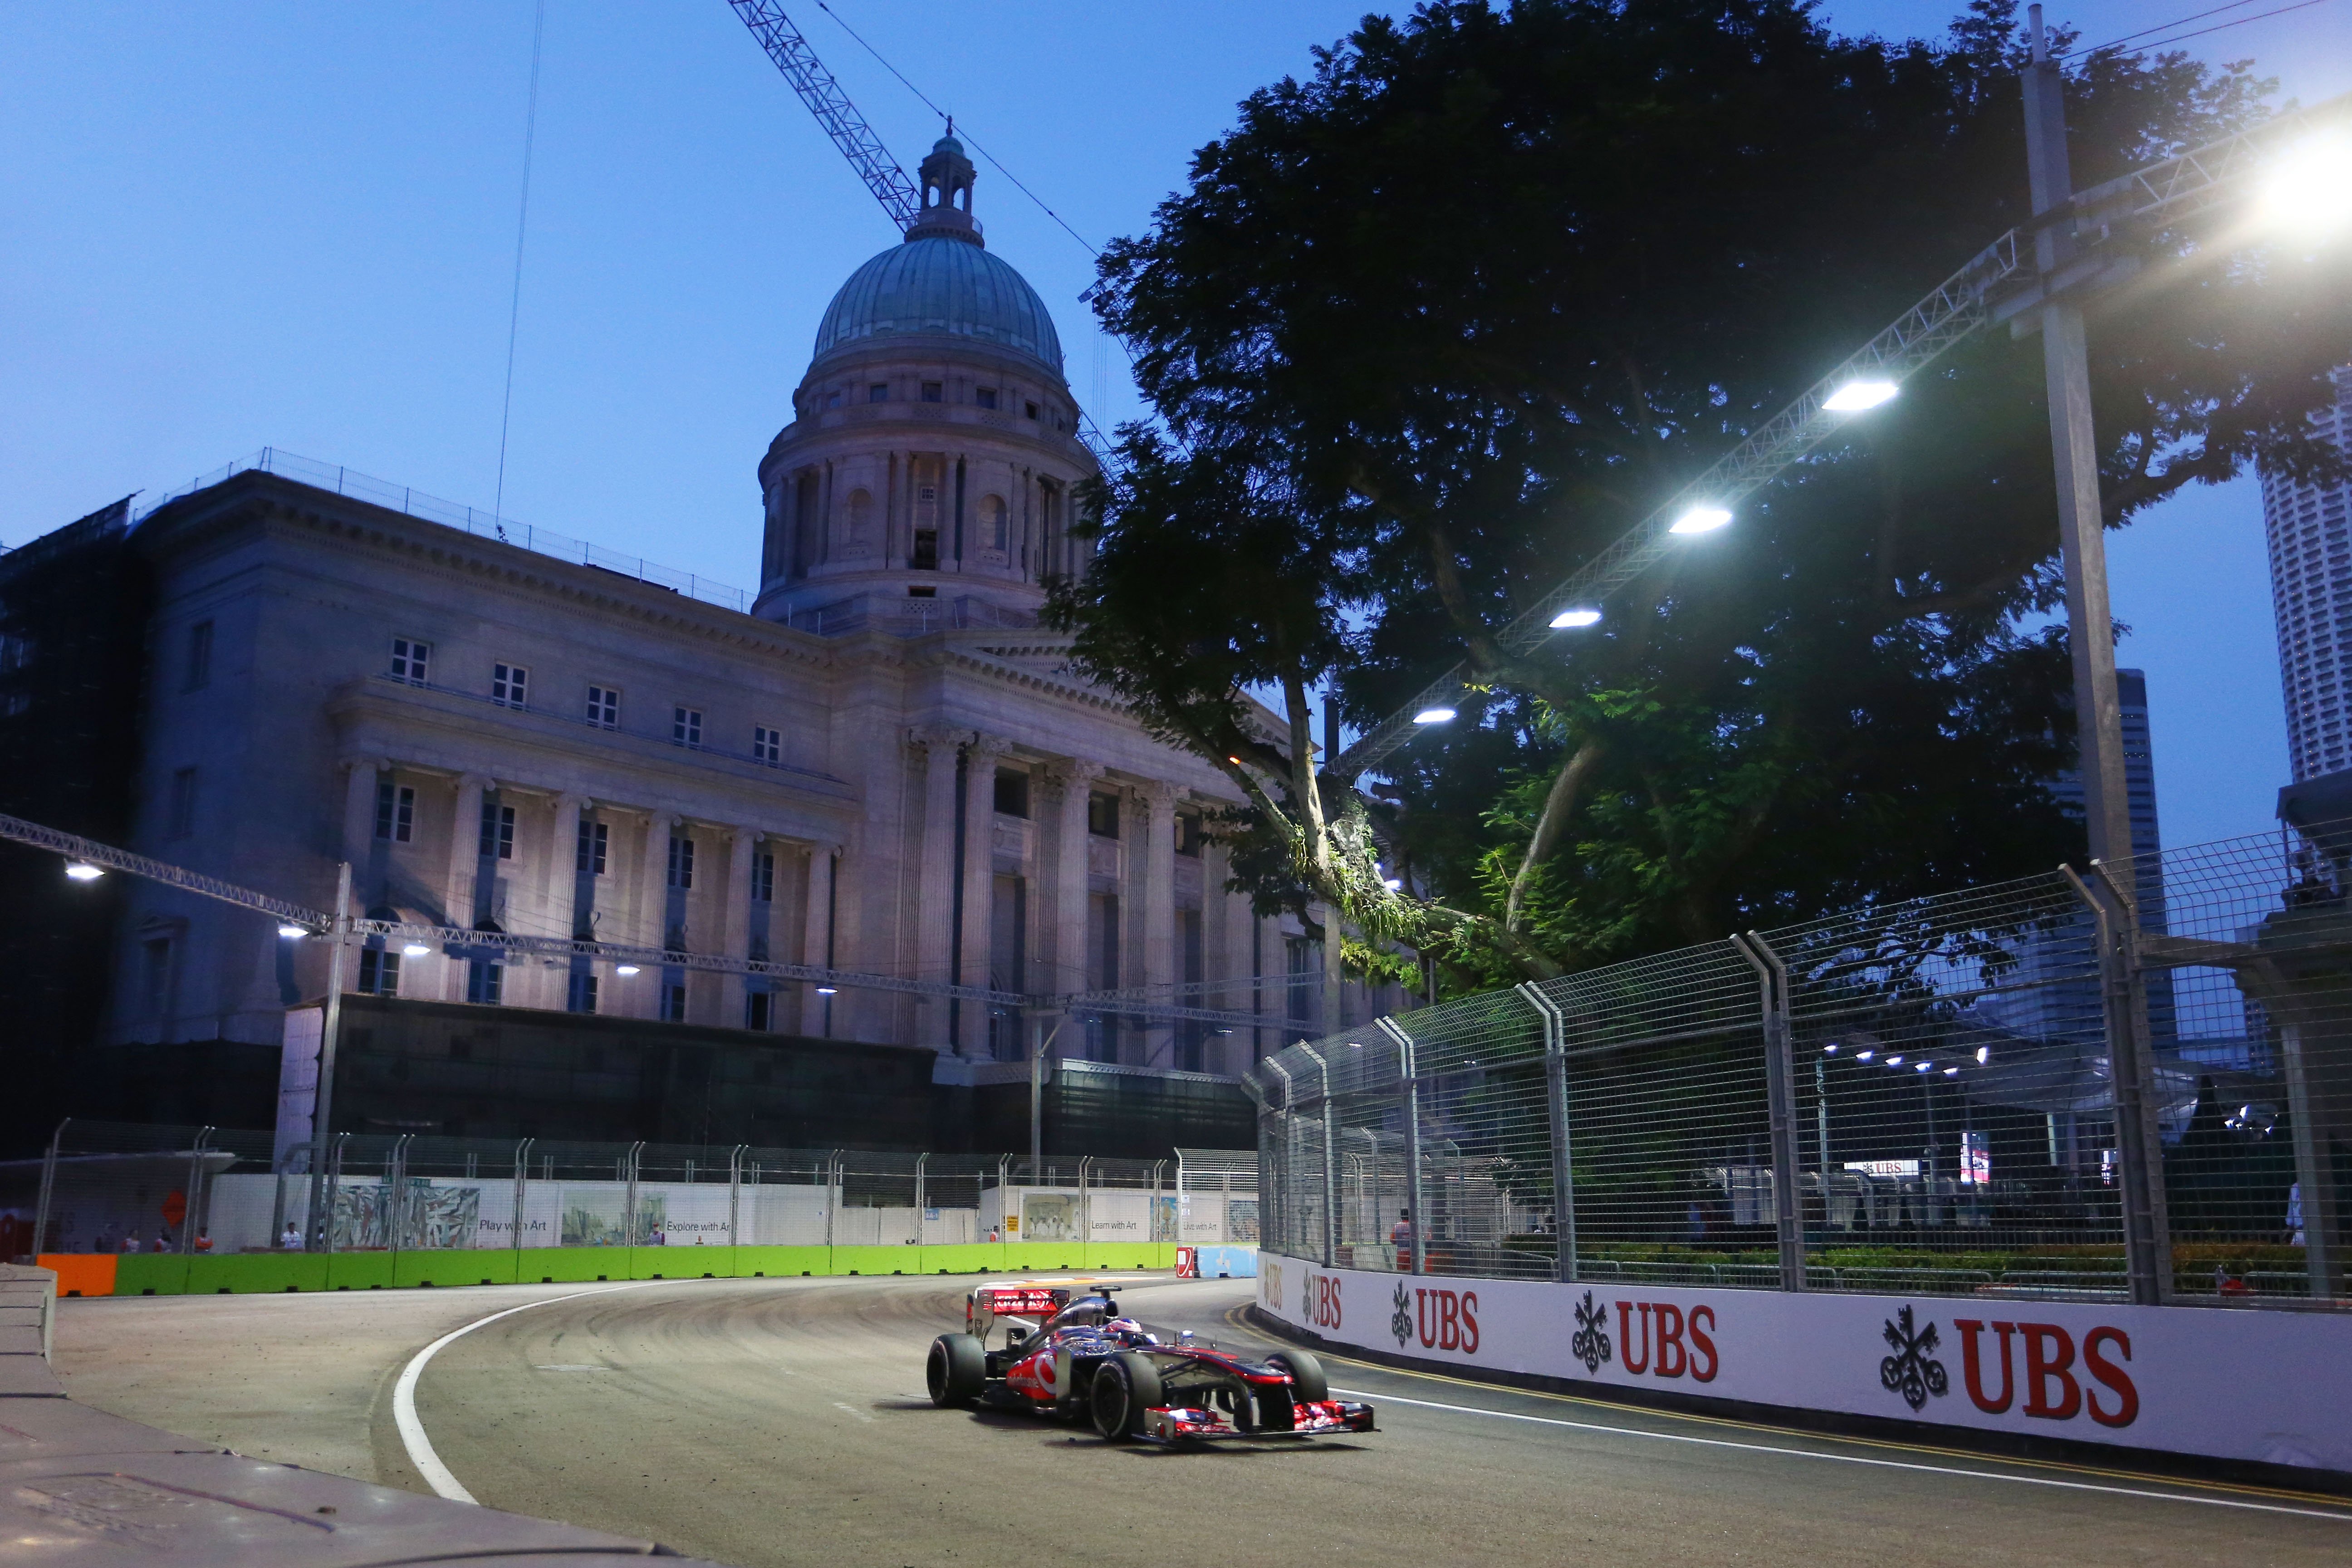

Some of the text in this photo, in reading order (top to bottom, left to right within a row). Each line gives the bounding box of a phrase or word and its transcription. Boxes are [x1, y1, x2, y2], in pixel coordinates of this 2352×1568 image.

[1875, 1162, 1901, 1173] UBS
[480, 1220, 502, 1232] Play
[530, 1220, 546, 1230] Art
[667, 1221, 730, 1232] Explore with Ar
[1092, 1220, 1137, 1229] Learn with Art
[1183, 1222, 1195, 1230] Live
[1269, 1264, 1282, 1310] UBS
[1313, 1274, 1341, 1330] UBS
[1416, 1288, 1479, 1354] UBS
[1615, 1301, 1719, 1382] UBS
[1954, 1318, 2139, 1427] UBS
